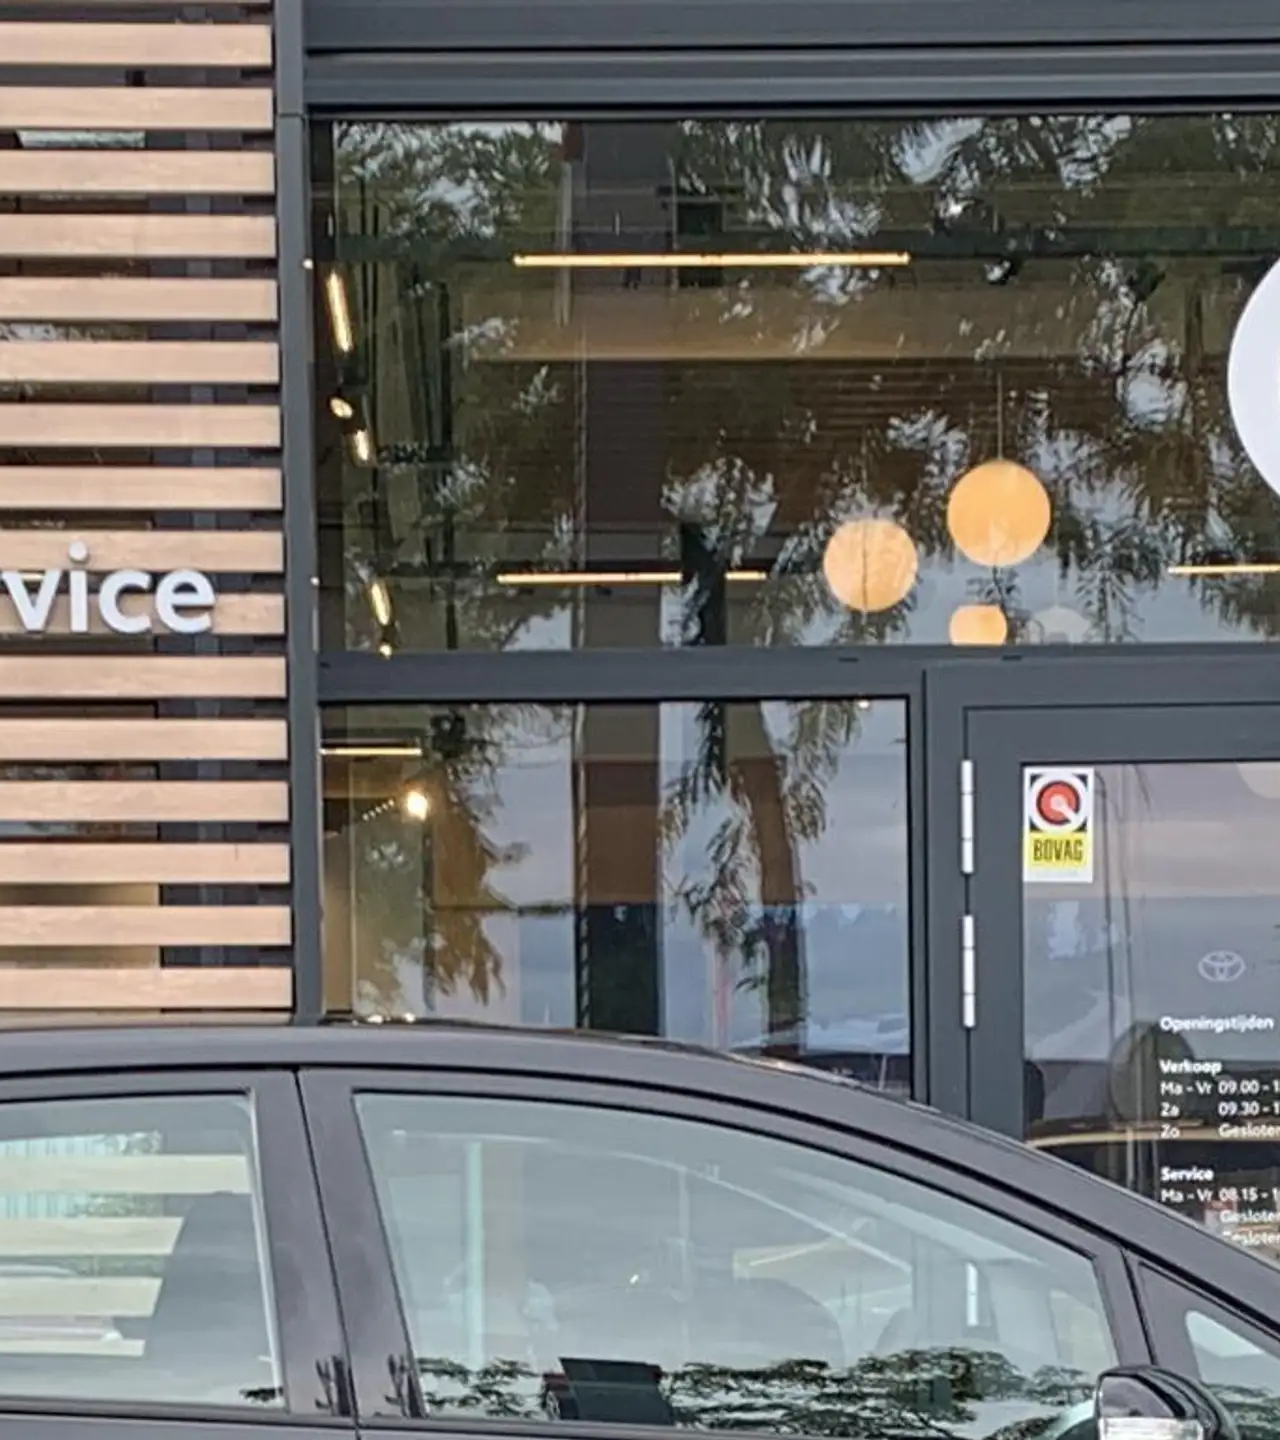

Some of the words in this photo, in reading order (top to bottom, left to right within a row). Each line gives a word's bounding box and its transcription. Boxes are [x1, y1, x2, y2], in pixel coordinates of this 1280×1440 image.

[1033, 839, 1083, 862] BOVAG
[1160, 1015, 1274, 1033] Openingstijden
[1160, 1059, 1222, 1076] Verkoop
[1160, 1081, 1183, 1096] Ma
[1195, 1081, 1213, 1095] Vr
[1218, 1080, 1260, 1095] 09.00
[1160, 1102, 1180, 1117] Za
[1218, 1101, 1260, 1116] 09.30
[1160, 1124, 1181, 1139] Zo
[1160, 1166, 1215, 1182] Service
[1160, 1188, 1184, 1203] Ma
[1196, 1188, 1213, 1202] Vr
